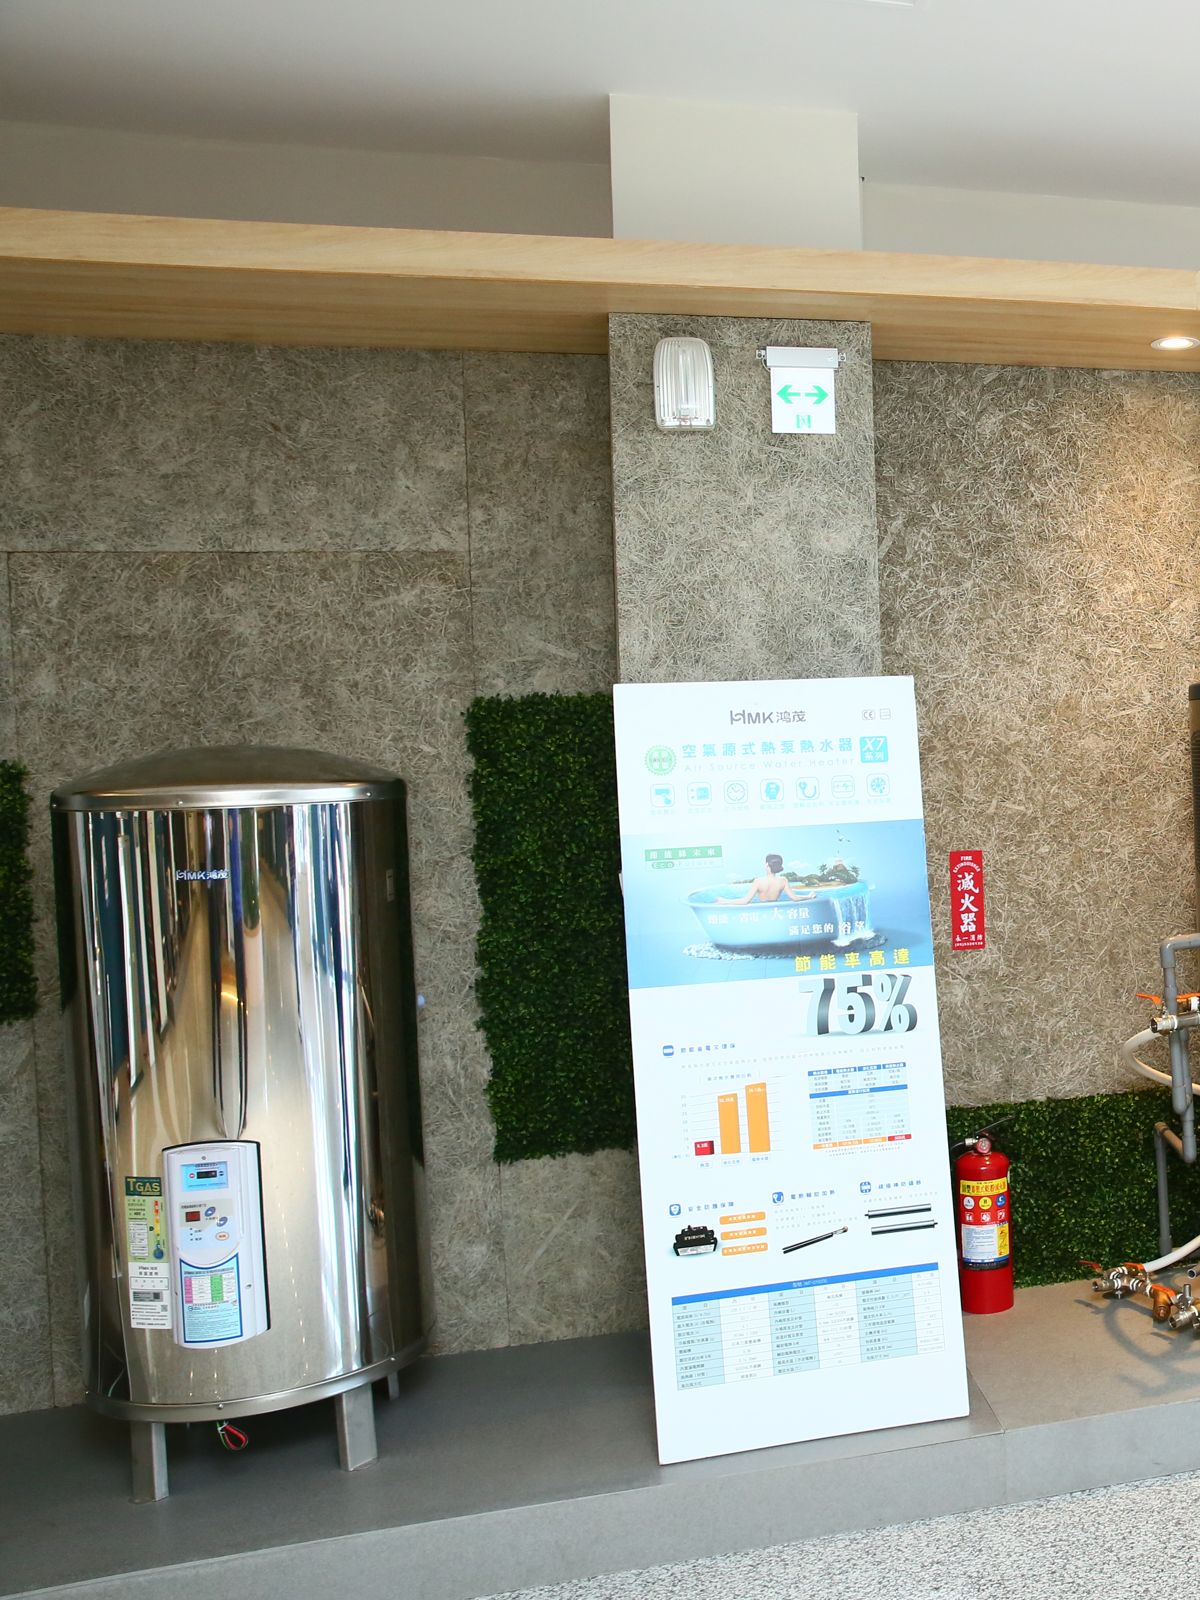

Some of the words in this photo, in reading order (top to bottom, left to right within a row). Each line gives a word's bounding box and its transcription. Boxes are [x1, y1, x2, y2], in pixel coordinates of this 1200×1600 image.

[957, 872, 980, 933] 滅火器
[794, 948, 911, 973] 節能率高達
[798, 973, 918, 1036] 75%
